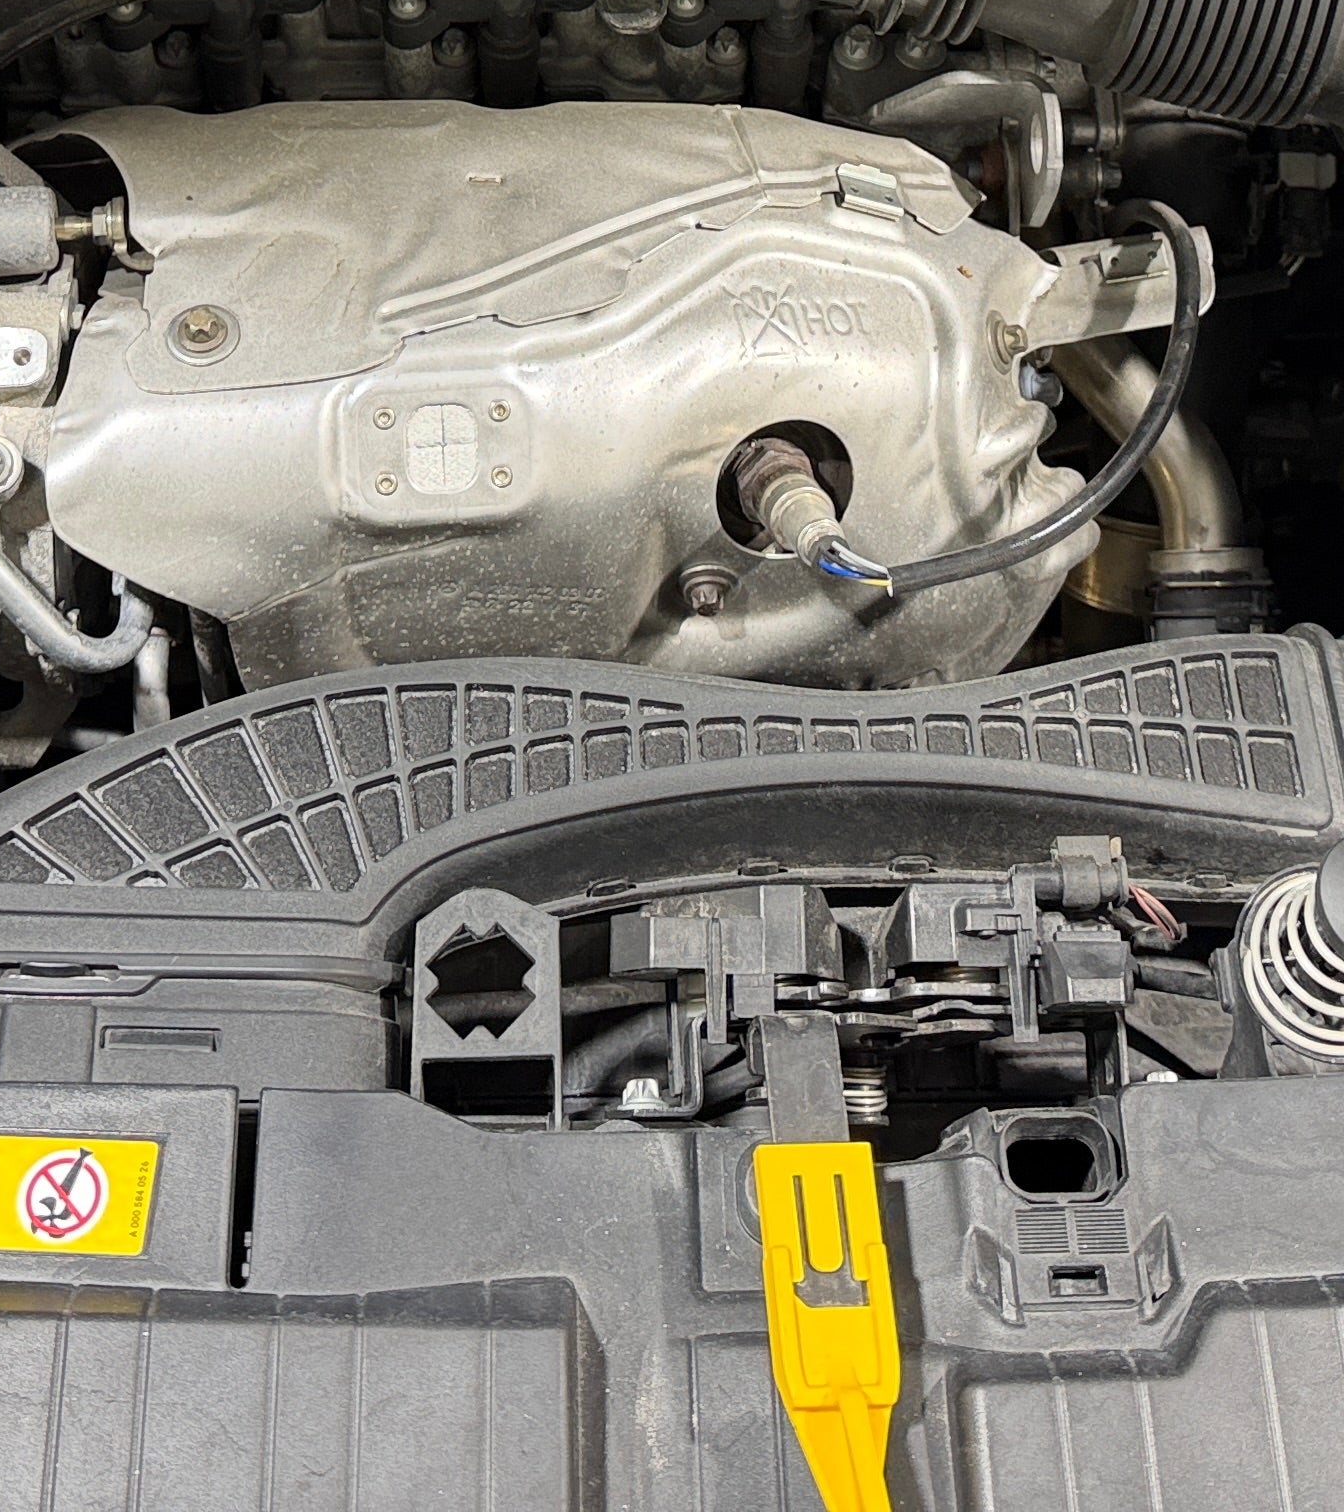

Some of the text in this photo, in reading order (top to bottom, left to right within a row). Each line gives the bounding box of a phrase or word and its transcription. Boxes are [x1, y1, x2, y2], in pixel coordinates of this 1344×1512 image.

[798, 299, 870, 336] HOT
[128, 1160, 149, 1237] A 000 584 05 26
